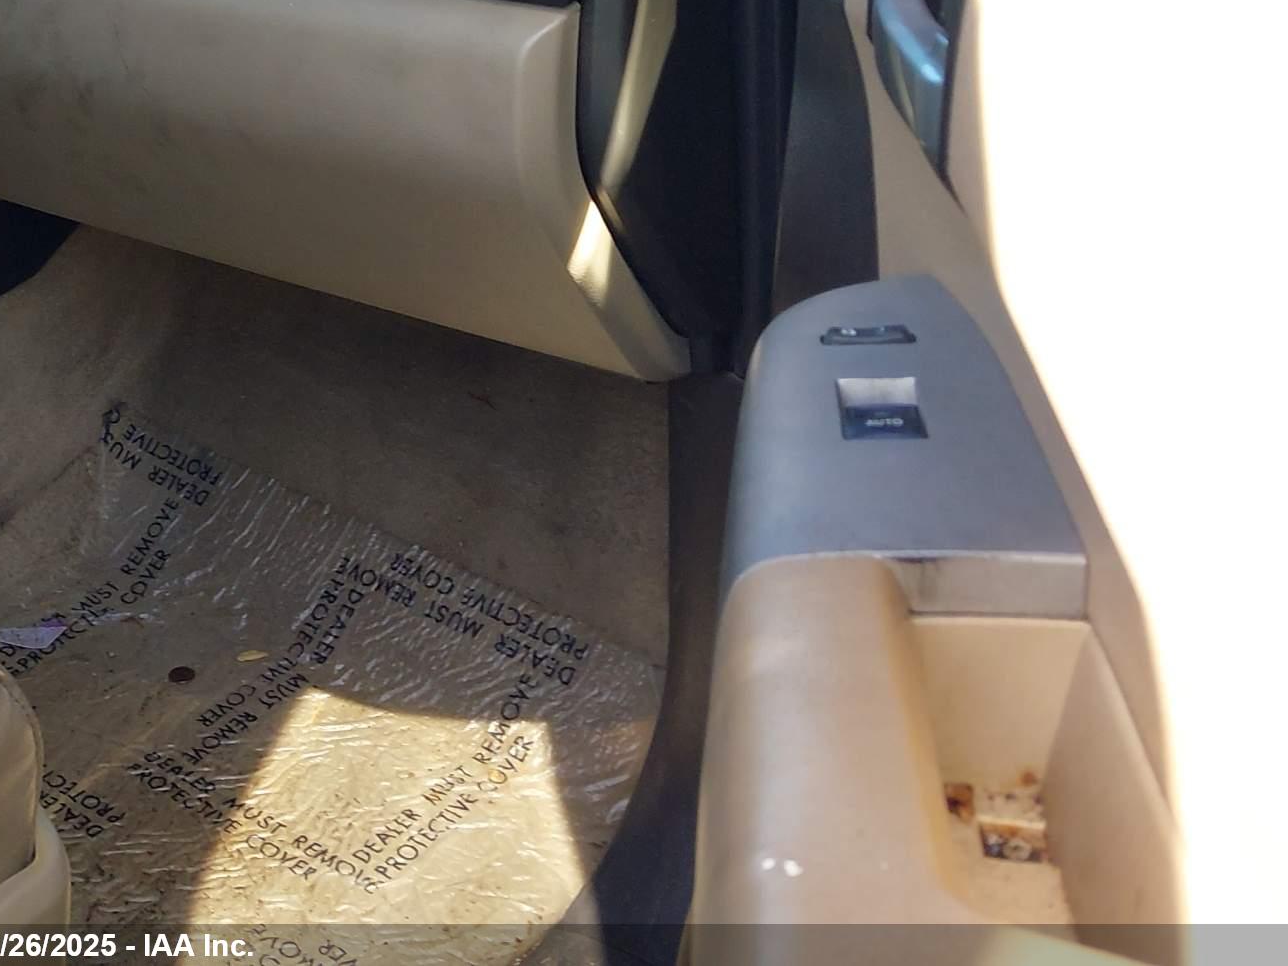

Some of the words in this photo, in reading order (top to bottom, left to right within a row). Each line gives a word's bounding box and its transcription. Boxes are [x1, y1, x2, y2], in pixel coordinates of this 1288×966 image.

[865, 417, 904, 427] AUTO
[123, 423, 223, 487] PROTECTIVE
[147, 466, 211, 507] DEALER
[121, 496, 180, 576] REMOVE
[120, 548, 171, 607] COVER
[336, 555, 418, 609] REMOVE
[391, 551, 454, 594] COVER
[312, 587, 365, 666] DEALER
[423, 599, 484, 639] MUST
[461, 589, 589, 661] PROTECTIVE
[494, 632, 577, 686] DEALER
[196, 684, 256, 728] COVER
[260, 673, 309, 711] MUST
[182, 712, 258, 766] REMOVE
[143, 751, 217, 794] DEALER
[221, 797, 288, 835] MUST
[353, 808, 423, 864] DEALER
[423, 764, 474, 806] MUST
[473, 673, 539, 765] REMOVE
[126, 763, 242, 835] PROTECTIVE
[245, 833, 317, 881] COVER
[375, 792, 479, 881] PROTECTIVE
[478, 735, 536, 793] COVER
